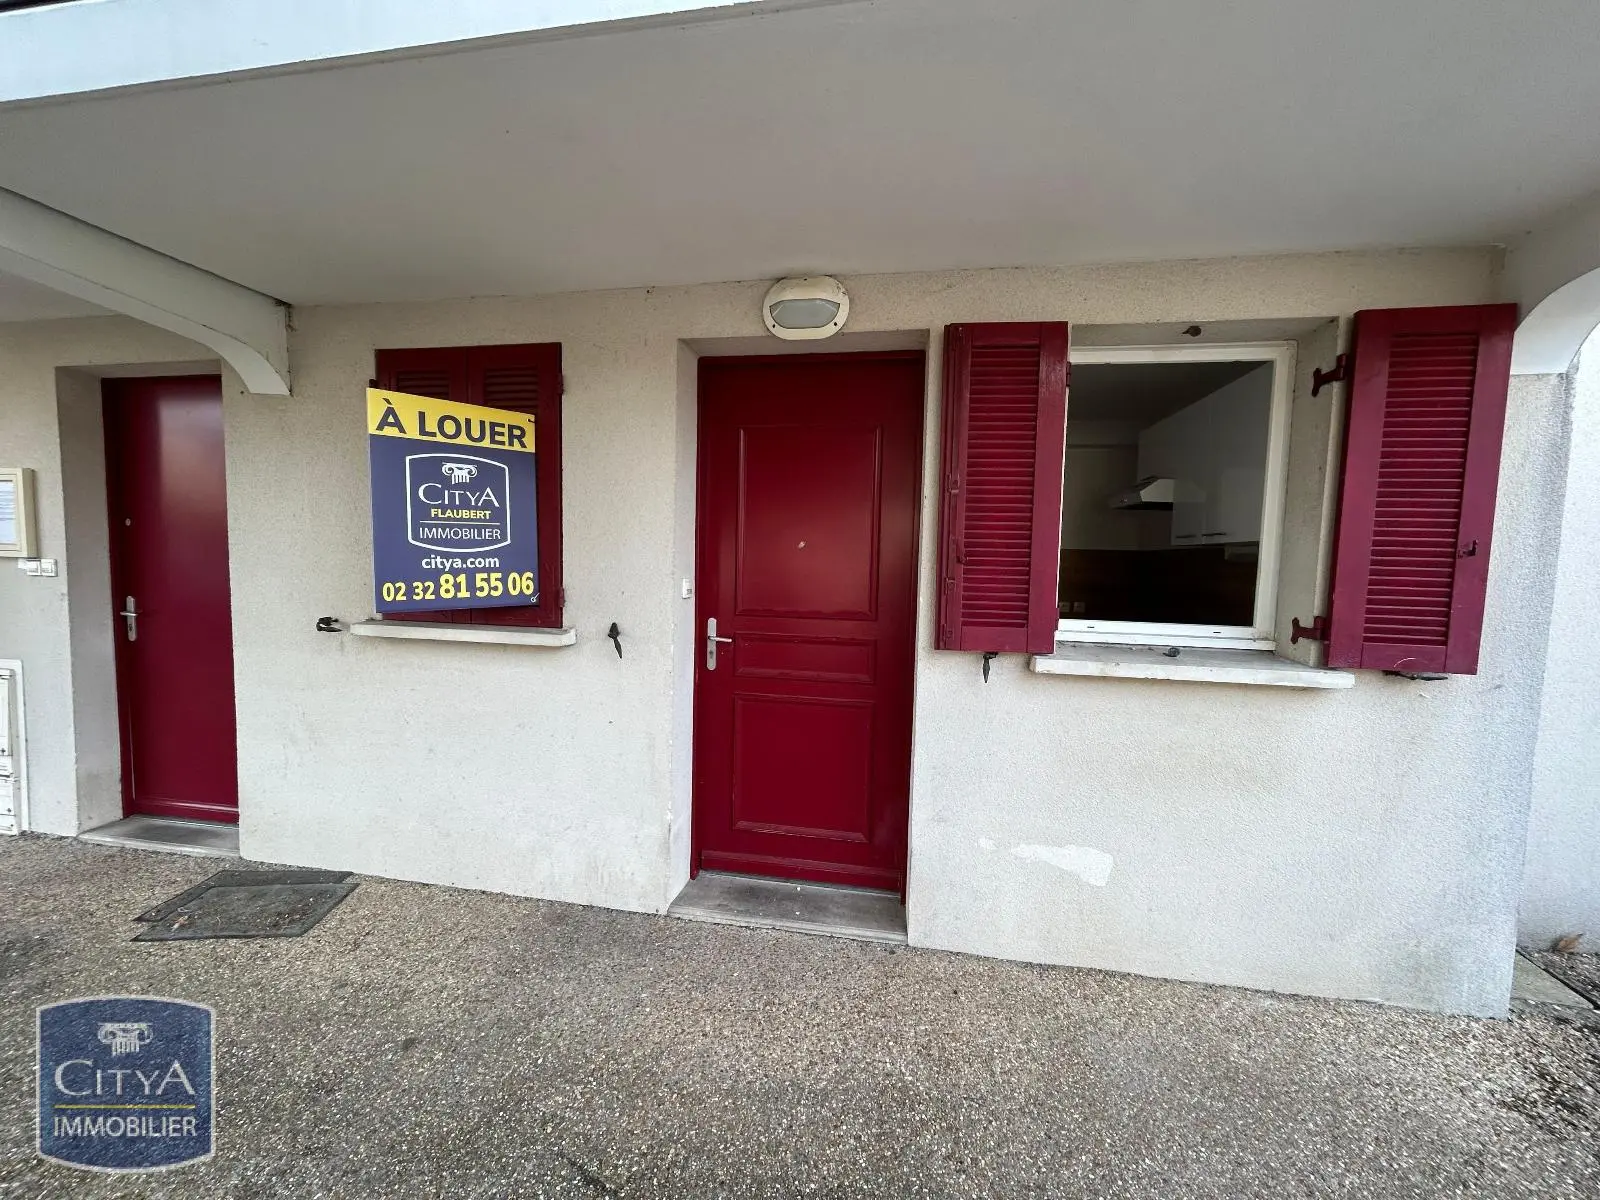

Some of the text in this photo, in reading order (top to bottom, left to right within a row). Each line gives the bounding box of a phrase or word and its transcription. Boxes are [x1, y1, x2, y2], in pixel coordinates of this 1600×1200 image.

[375, 397, 528, 448] À LOUER
[430, 508, 492, 519] FLAUBERT
[419, 527, 501, 540] IMMOBILIER
[421, 554, 500, 571] citya.com
[382, 571, 534, 601] 02 32 81 55 06
